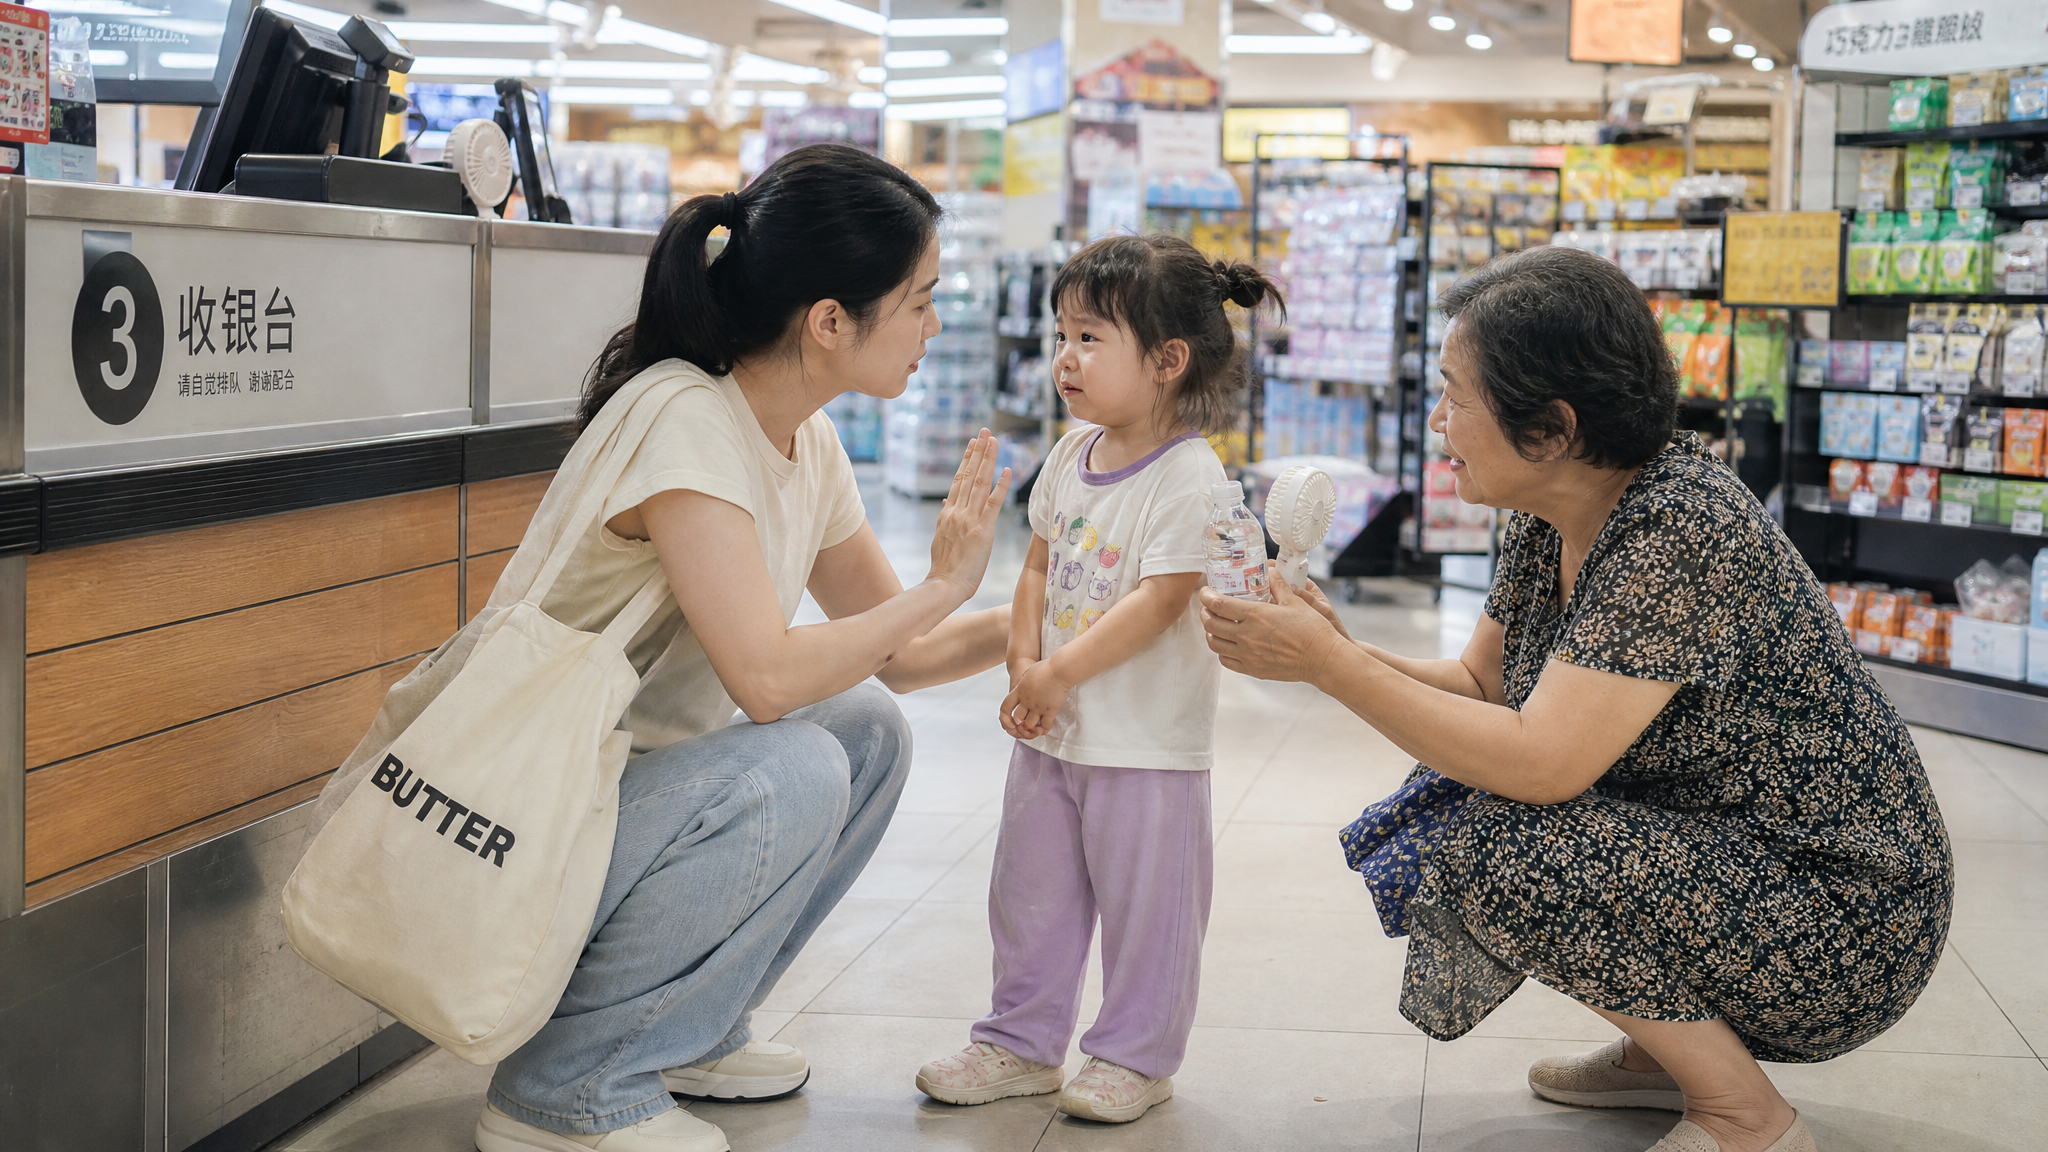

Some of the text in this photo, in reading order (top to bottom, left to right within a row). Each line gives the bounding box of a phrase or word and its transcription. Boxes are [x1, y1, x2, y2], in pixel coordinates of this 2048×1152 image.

[100, 285, 138, 391] 3
[178, 285, 296, 356] 收银台
[178, 368, 295, 397] 请自觉排队 谢谢配合
[370, 752, 516, 869] BUTTER
